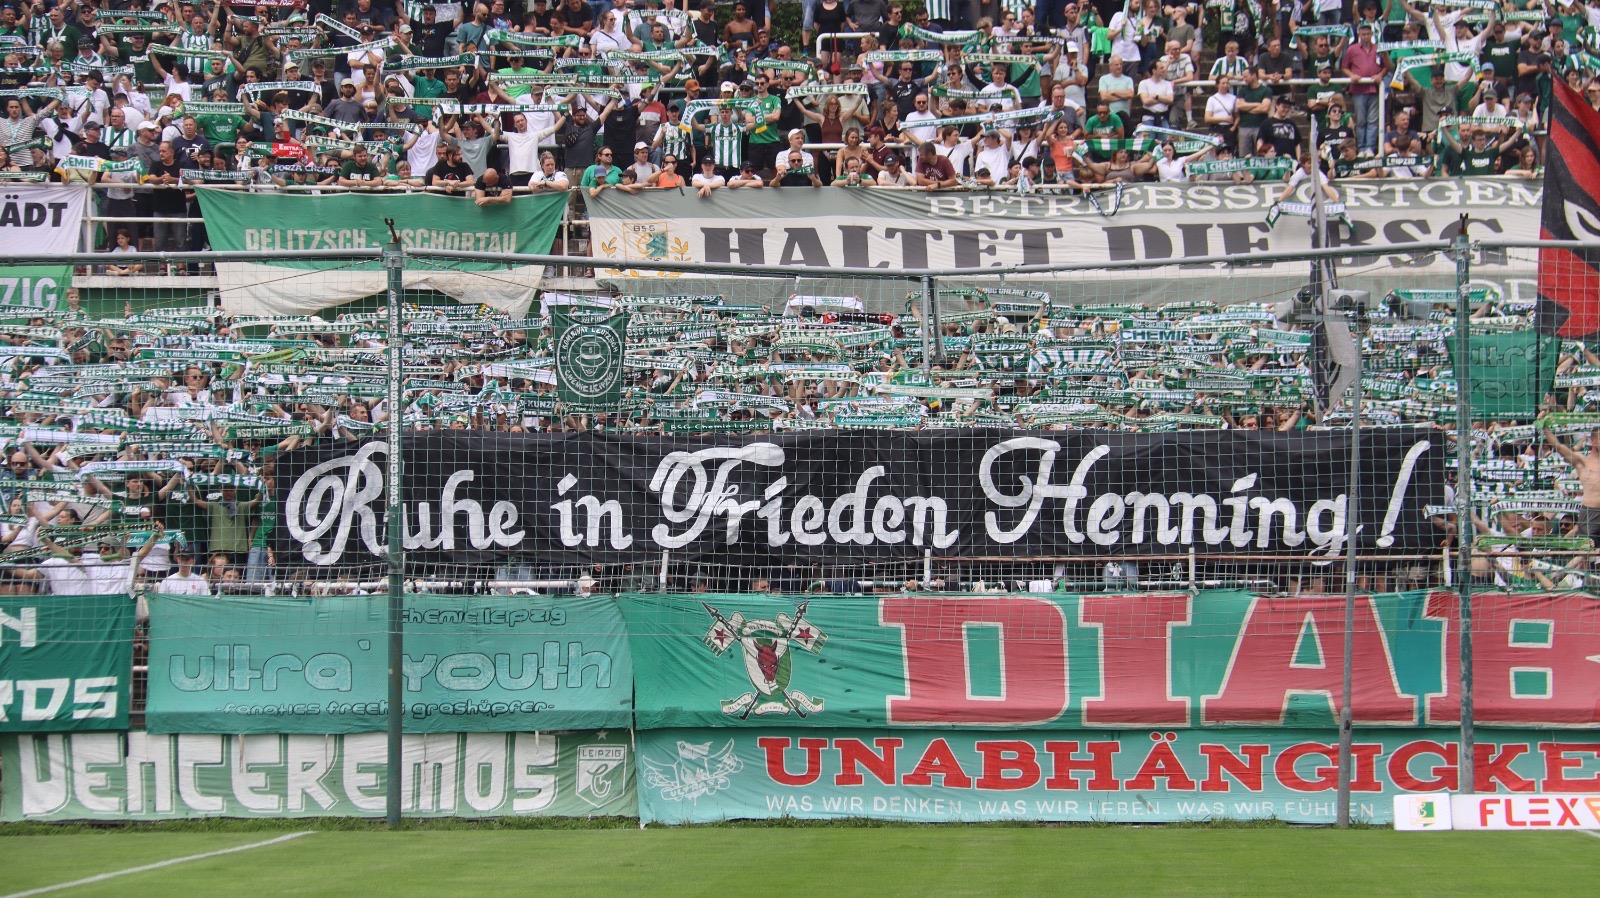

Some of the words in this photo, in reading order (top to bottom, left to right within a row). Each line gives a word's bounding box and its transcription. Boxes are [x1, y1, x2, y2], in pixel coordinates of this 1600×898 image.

[413, 55, 437, 65] CHEMIE
[438, 54, 460, 63] LEIPZIG
[602, 75, 626, 84] CHEMIE
[198, 104, 226, 113] CHEMIE
[1209, 158, 1248, 171] CHEMIE
[1386, 156, 1416, 166] LEIPZIG
[273, 163, 302, 172] FORZA
[633, 224, 656, 232] BSG
[245, 228, 368, 251] DELITZSCH
[700, 223, 1064, 269] HALTET
[1101, 221, 1276, 270] DIE
[1326, 217, 1510, 269] BSG
[997, 303, 1011, 312] BSG
[1082, 303, 1110, 311] CHEMIE
[1113, 302, 1143, 311] LEIPZIG
[626, 327, 645, 336] BSG
[1119, 330, 1189, 342] CHEMIE
[841, 333, 872, 346] CHEMIE
[1278, 332, 1300, 342] LEIPZIG
[984, 342, 1028, 351] LEIPZIG
[80, 368, 123, 378] CHEMIE
[270, 364, 297, 374] CHEMIE
[564, 369, 589, 393] CHEMIE
[655, 407, 681, 418] CHEMIE
[683, 407, 710, 418] LEIPZIG
[236, 427, 252, 439] BSG
[252, 427, 283, 438] CHEMIE
[284, 424, 312, 435] LEIPZIG
[285, 440, 527, 566] Ruhe
[550, 472, 634, 550] in
[649, 441, 960, 549] Frieden
[978, 435, 1364, 566] Henning
[482, 607, 567, 626] leipzig
[325, 699, 405, 717] frech
[581, 749, 621, 758] LEIPZIG
[765, 795, 813, 812] WAS
[822, 796, 864, 812] WIR
[979, 799, 1026, 814] WAS
[1035, 800, 1079, 815] WIR
[1176, 801, 1225, 816] WAS
[1234, 802, 1274, 816] WIR
